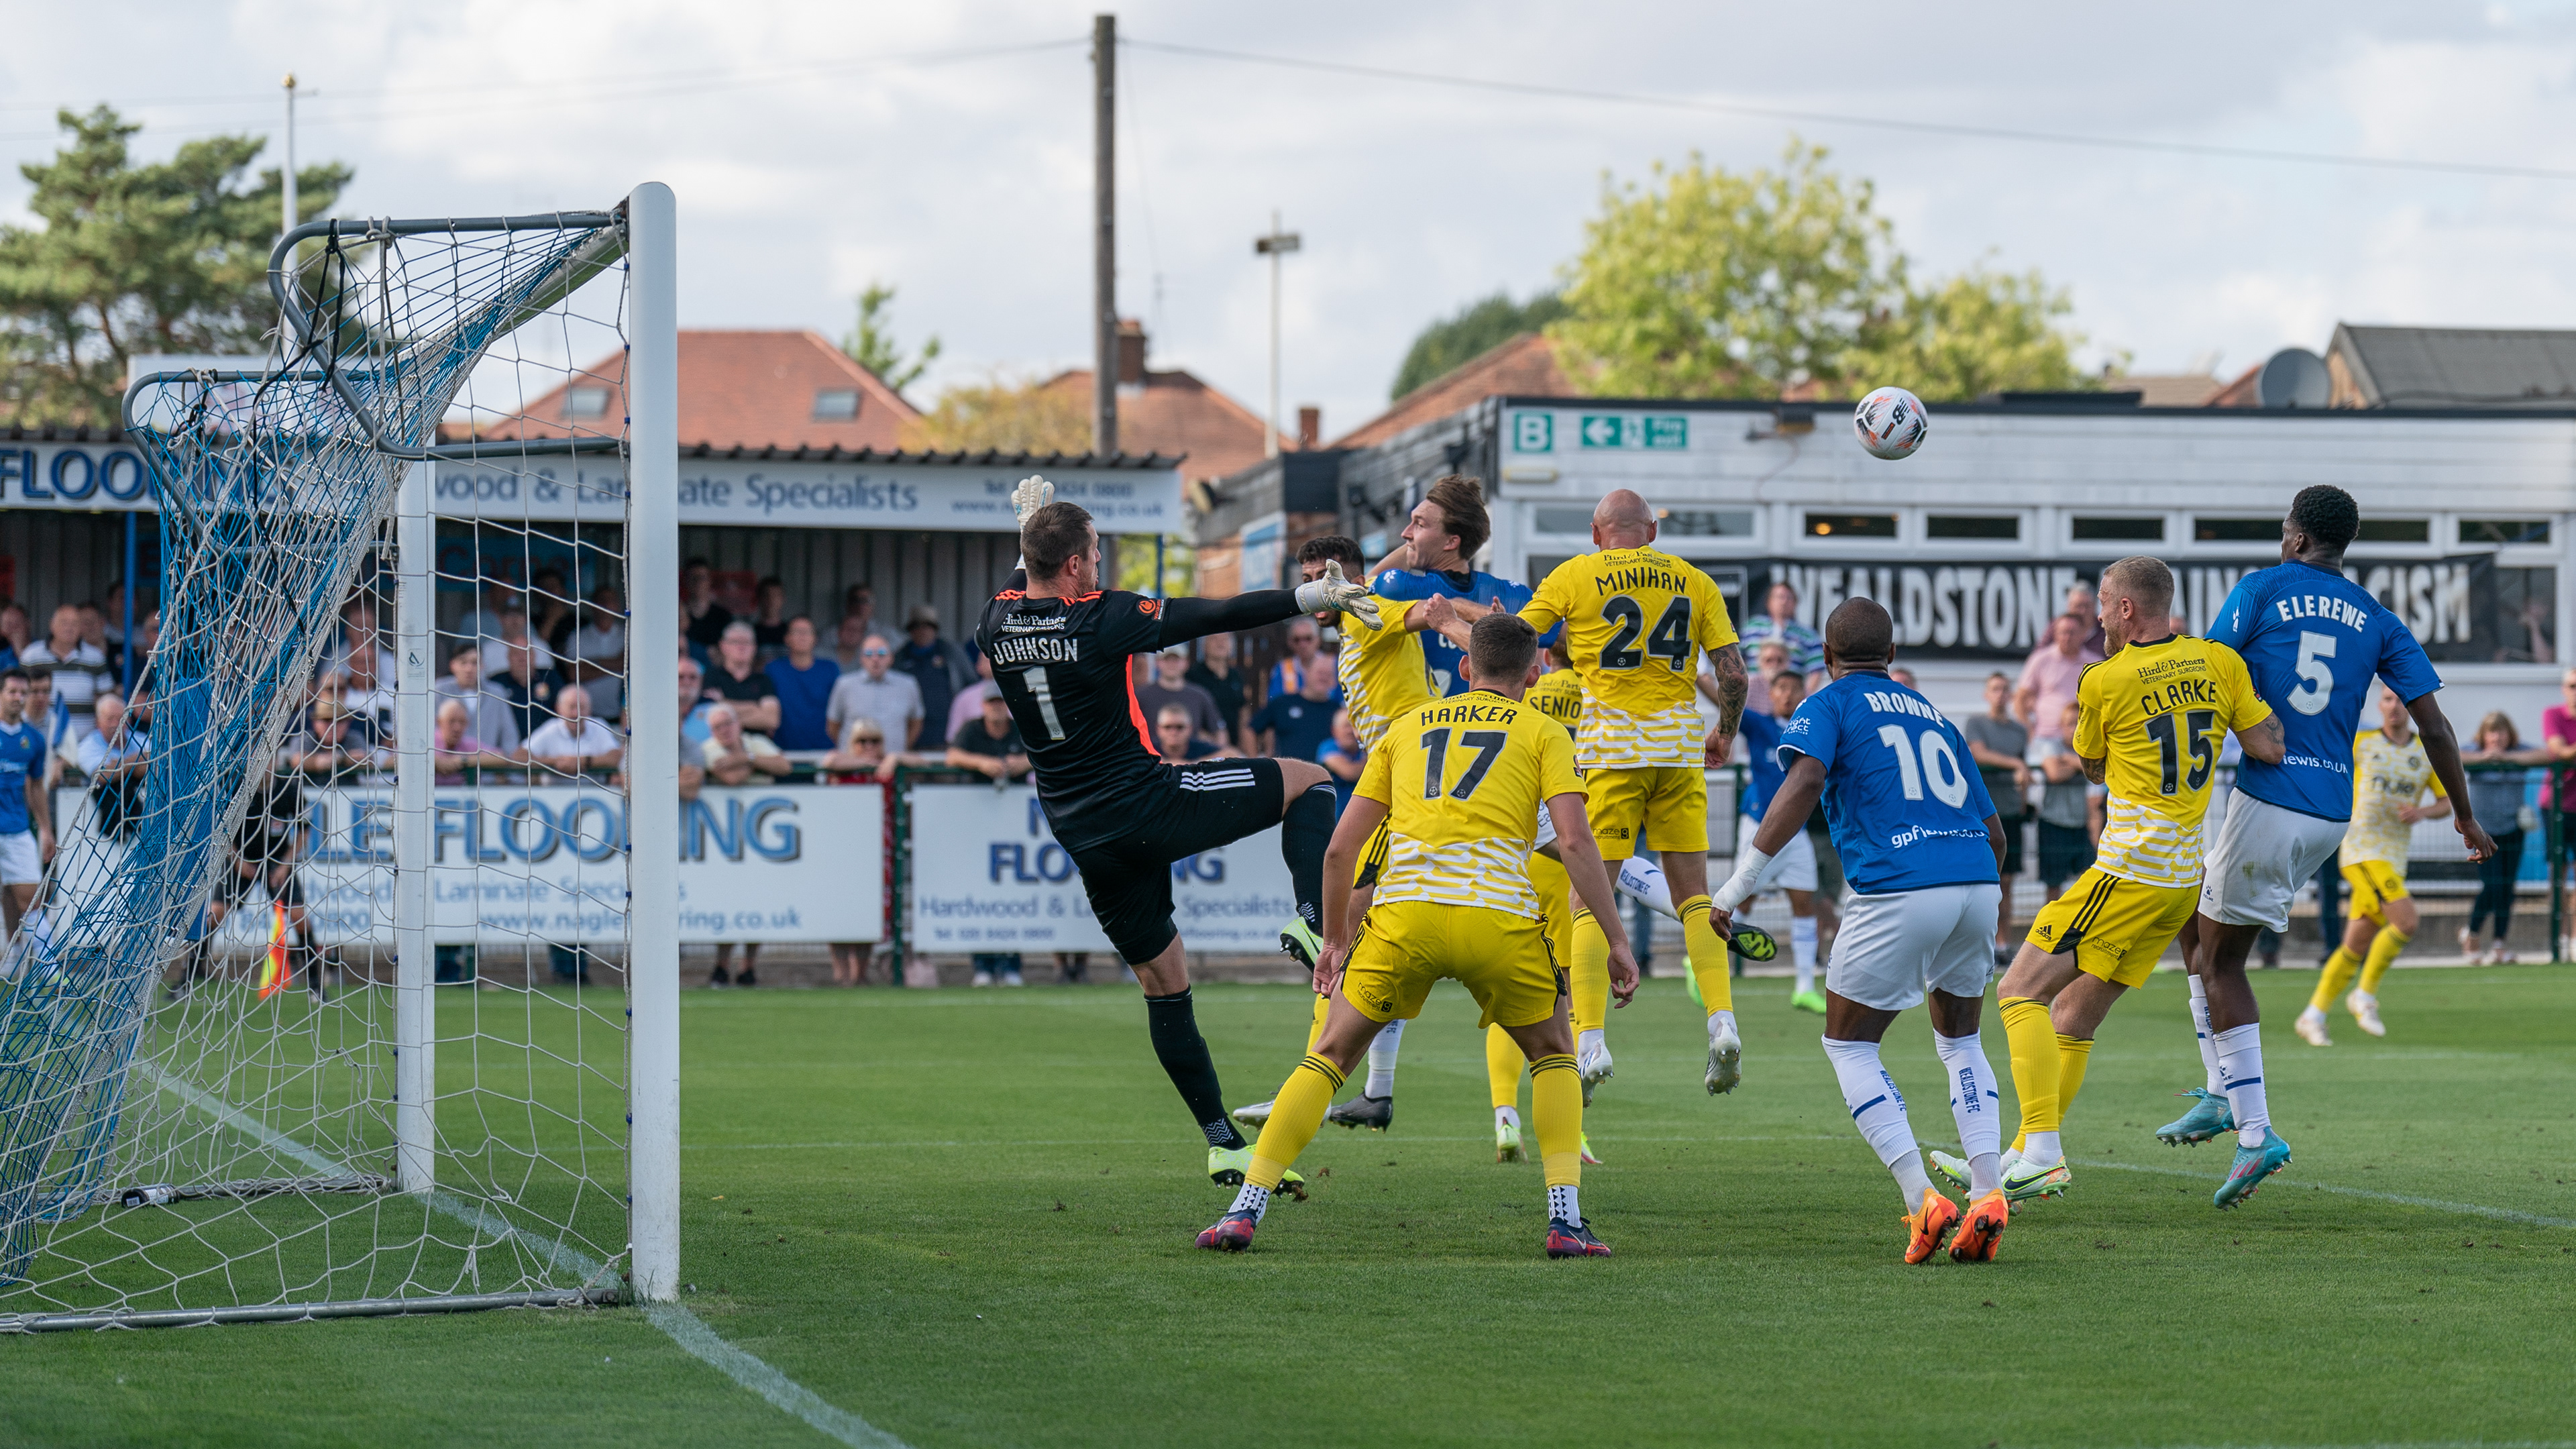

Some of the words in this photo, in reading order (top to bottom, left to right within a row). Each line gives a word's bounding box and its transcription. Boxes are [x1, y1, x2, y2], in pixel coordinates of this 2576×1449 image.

[1517, 416, 1548, 450] B
[745, 472, 919, 516] Specialists
[1605, 557, 1641, 567] VETERINARY
[1595, 567, 1686, 596] MINIHAN
[2276, 594, 2368, 633] ELEREWE
[1600, 594, 1693, 672] 24
[994, 637, 1077, 665] JOHNSON
[2141, 671, 2177, 685] VETERINARY
[2178, 665, 2207, 675] SURGEONS
[2287, 630, 2337, 716] 5
[1022, 666, 1066, 740] 1
[1529, 695, 1581, 719] SENIO
[1864, 691, 1945, 729] BROWNE
[2141, 678, 2216, 716] CLARKE
[1421, 705, 1518, 727] HARKER
[1420, 727, 1508, 801] 17
[1877, 724, 1968, 809] 10
[2145, 710, 2214, 796] 15
[2282, 755, 2349, 773] lewis.co.uk
[434, 796, 802, 864] FLOOING
[989, 843, 1226, 883] FLONG
[435, 877, 549, 903] Laminate
[920, 895, 1039, 918] Hardwood
[1047, 895, 1065, 918] &
[2035, 928, 2052, 941] adidas
[2092, 936, 2121, 955] maze
[2091, 944, 2119, 960] recruitment
[1959, 1067, 1979, 1106] WEALDSTONE
[1966, 1104, 1981, 1113] FC
